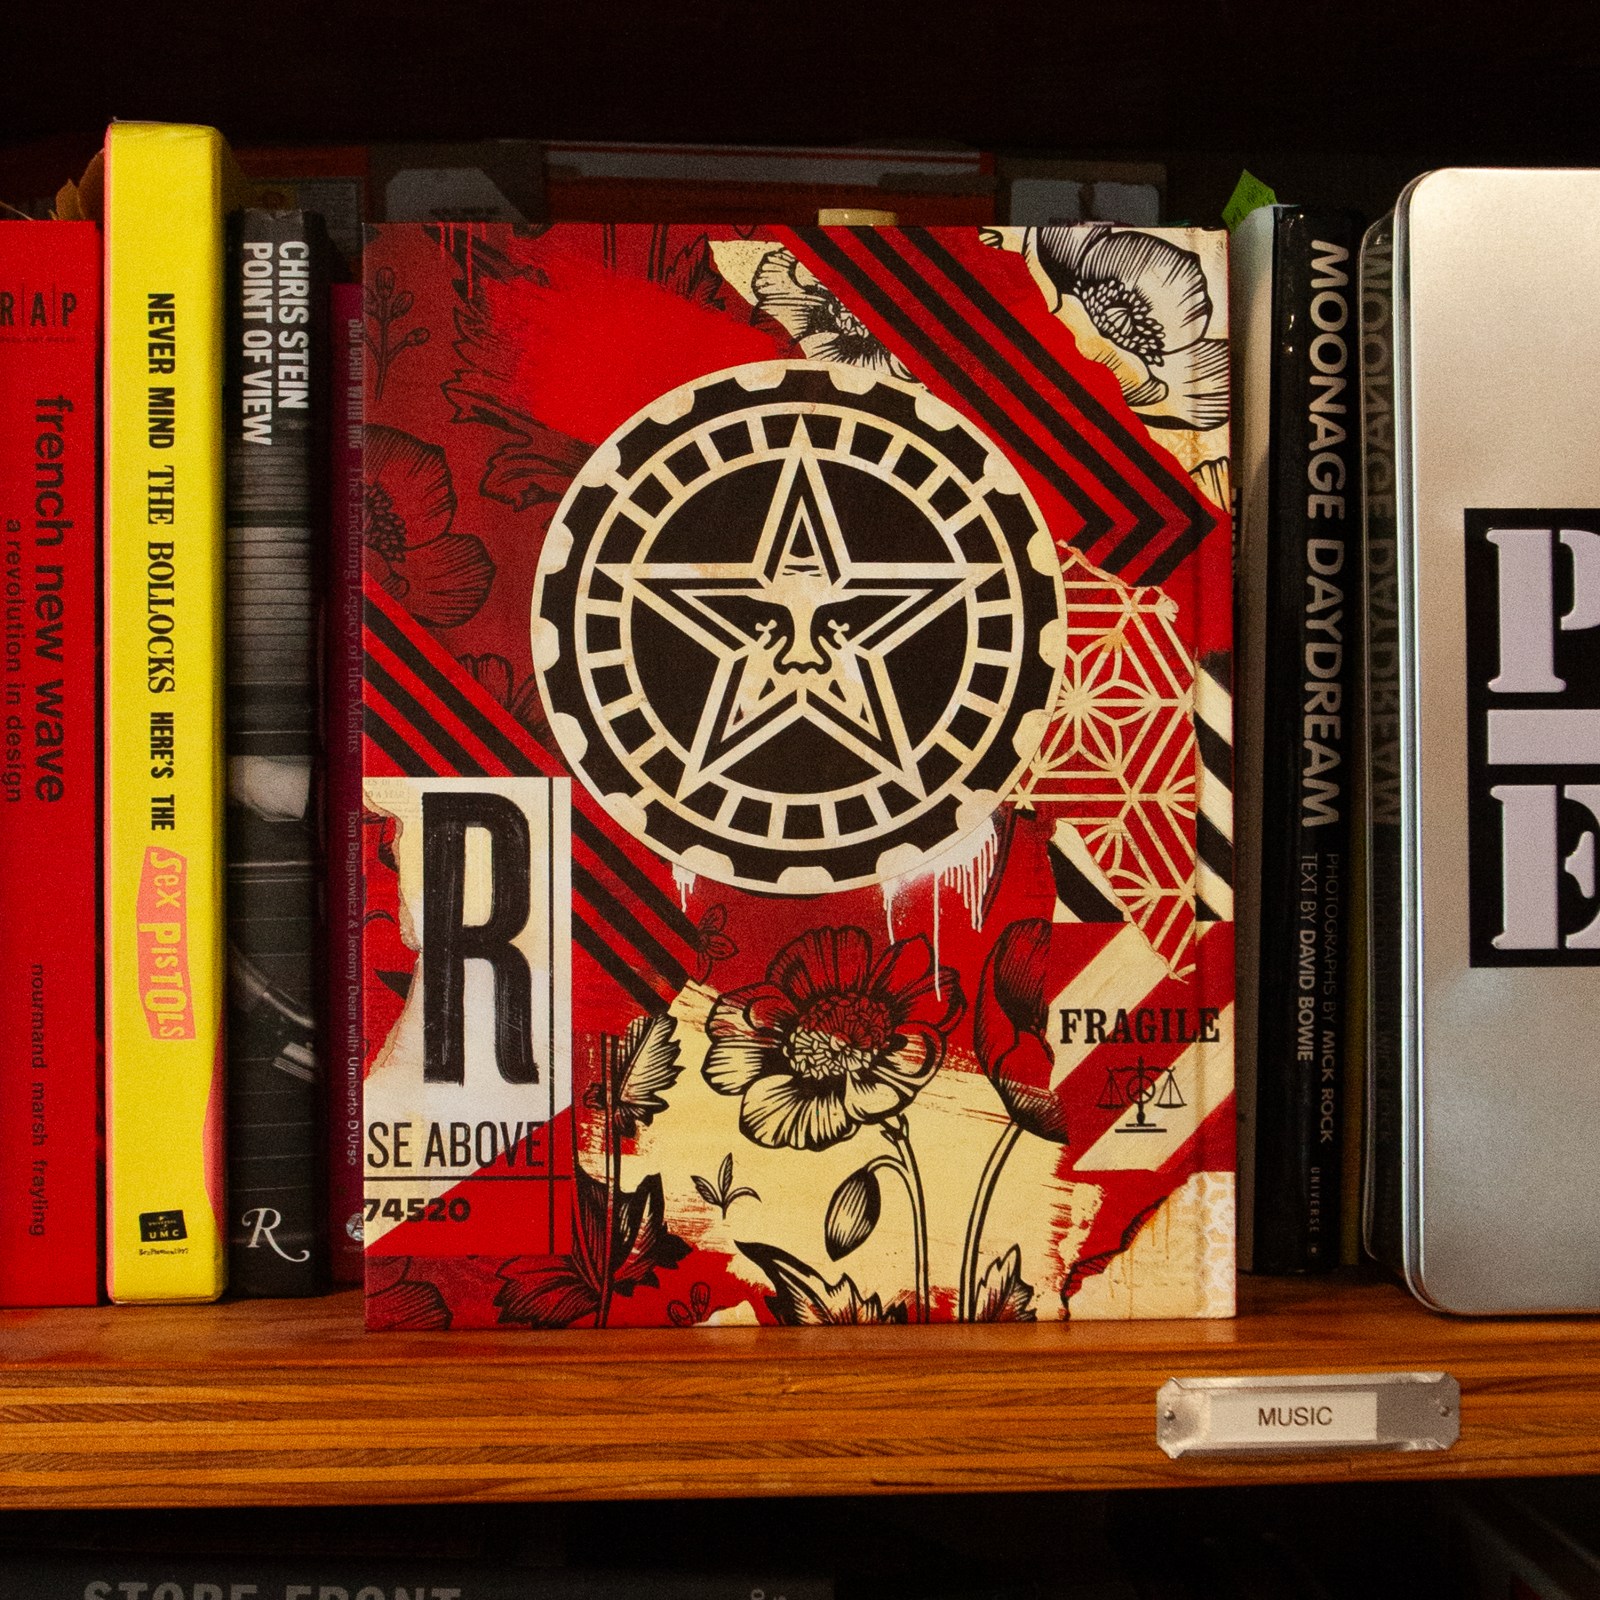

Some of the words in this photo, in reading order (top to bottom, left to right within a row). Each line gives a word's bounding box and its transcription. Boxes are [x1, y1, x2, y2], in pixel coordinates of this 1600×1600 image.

[242, 242, 273, 323] POINT
[278, 241, 310, 324] CHRIS
[147, 293, 176, 374] NEVER
[242, 329, 273, 364] OF
[278, 330, 310, 409] STEIN
[1308, 240, 1350, 520] MOONAGE
[147, 387, 176, 449] MIND
[242, 369, 273, 446] VIEW
[35, 395, 75, 547] french
[147, 465, 175, 525] THE
[6, 520, 21, 532] a
[5, 540, 26, 673] revolution
[35, 565, 65, 663] new
[147, 541, 175, 693] BOLLOCKS
[5, 683, 26, 705] in
[1302, 538, 1345, 828] DAYDREAM
[1, 715, 26, 803] design
[35, 681, 65, 803] wave
[149, 712, 175, 779] HERE'S
[150, 794, 175, 830] THE
[347, 810, 360, 837] Tom
[1300, 852, 1319, 894] TEXT
[421, 791, 540, 1086] R
[1299, 900, 1318, 923] BY
[1322, 853, 1339, 996] PHOTOGRAPHS
[345, 934, 360, 981] Jeremy
[1299, 929, 1317, 991] DAVID
[31, 963, 48, 1070] nourmand
[347, 985, 360, 1020] Dean
[1059, 1007, 1220, 1044] FRAGILE
[1297, 996, 1315, 1061] BOWIE
[1321, 1001, 1337, 1023] BY
[347, 1024, 360, 1052] with
[1320, 1029, 1336, 1082] MICK
[31, 1081, 48, 1146] marsh
[347, 1057, 360, 1117] Umberto
[1320, 1087, 1336, 1143] ROCK
[347, 1120, 360, 1166] D'Urso
[367, 1121, 413, 1168] SE
[424, 1120, 545, 1168] ABOVE
[29, 1159, 49, 1236] frayling
[364, 1197, 470, 1222] 74520
[1309, 1166, 1320, 1233] UNIVERSE
[148, 1229, 179, 1239] UMC
[1258, 1405, 1333, 1427] MUSIC
